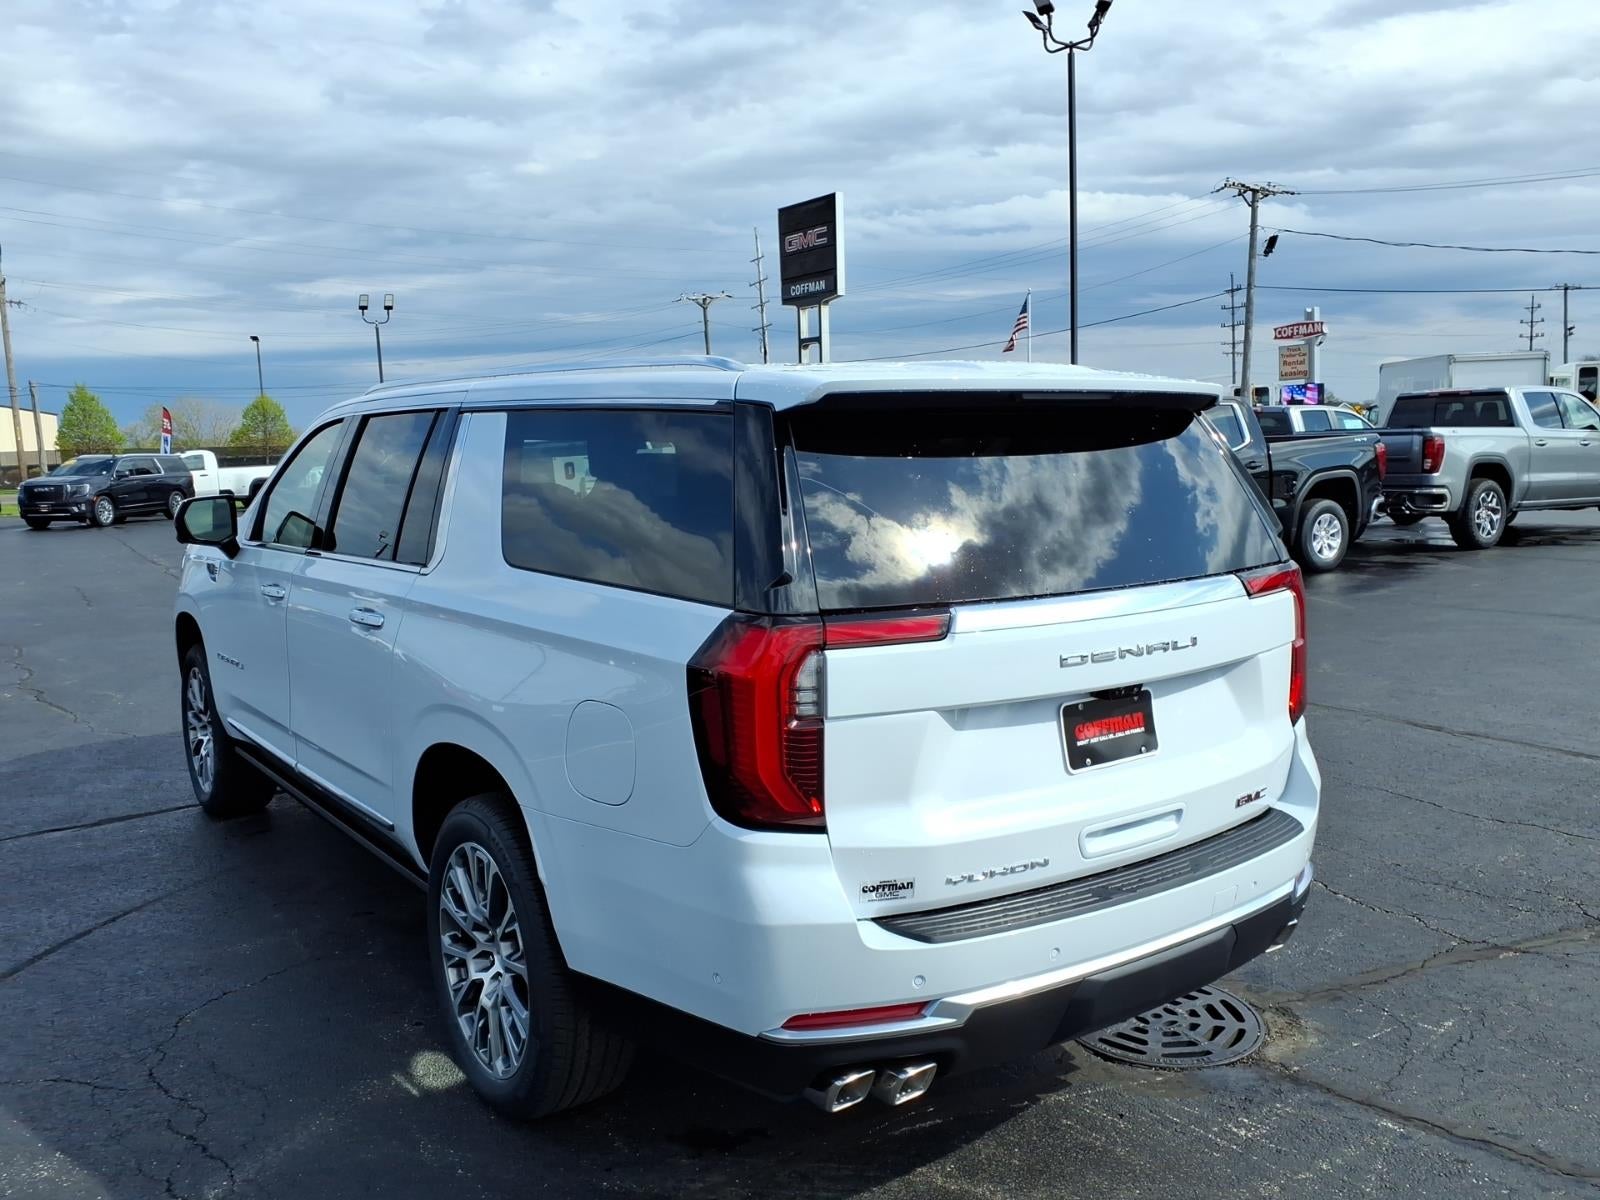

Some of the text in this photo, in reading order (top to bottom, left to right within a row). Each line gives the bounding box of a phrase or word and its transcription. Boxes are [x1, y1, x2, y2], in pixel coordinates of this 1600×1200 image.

[785, 226, 828, 252] GMC
[791, 280, 825, 296] COFFMAN
[1275, 323, 1322, 338] COFFMAN
[1281, 369, 1308, 377] Leasing
[1060, 636, 1198, 668] DENALI
[1074, 711, 1145, 740] COFFMAN
[1235, 787, 1268, 808] GMC
[945, 858, 1050, 885] YUKON
[862, 881, 914, 894] COFFMAN
[875, 890, 900, 899] GMC
